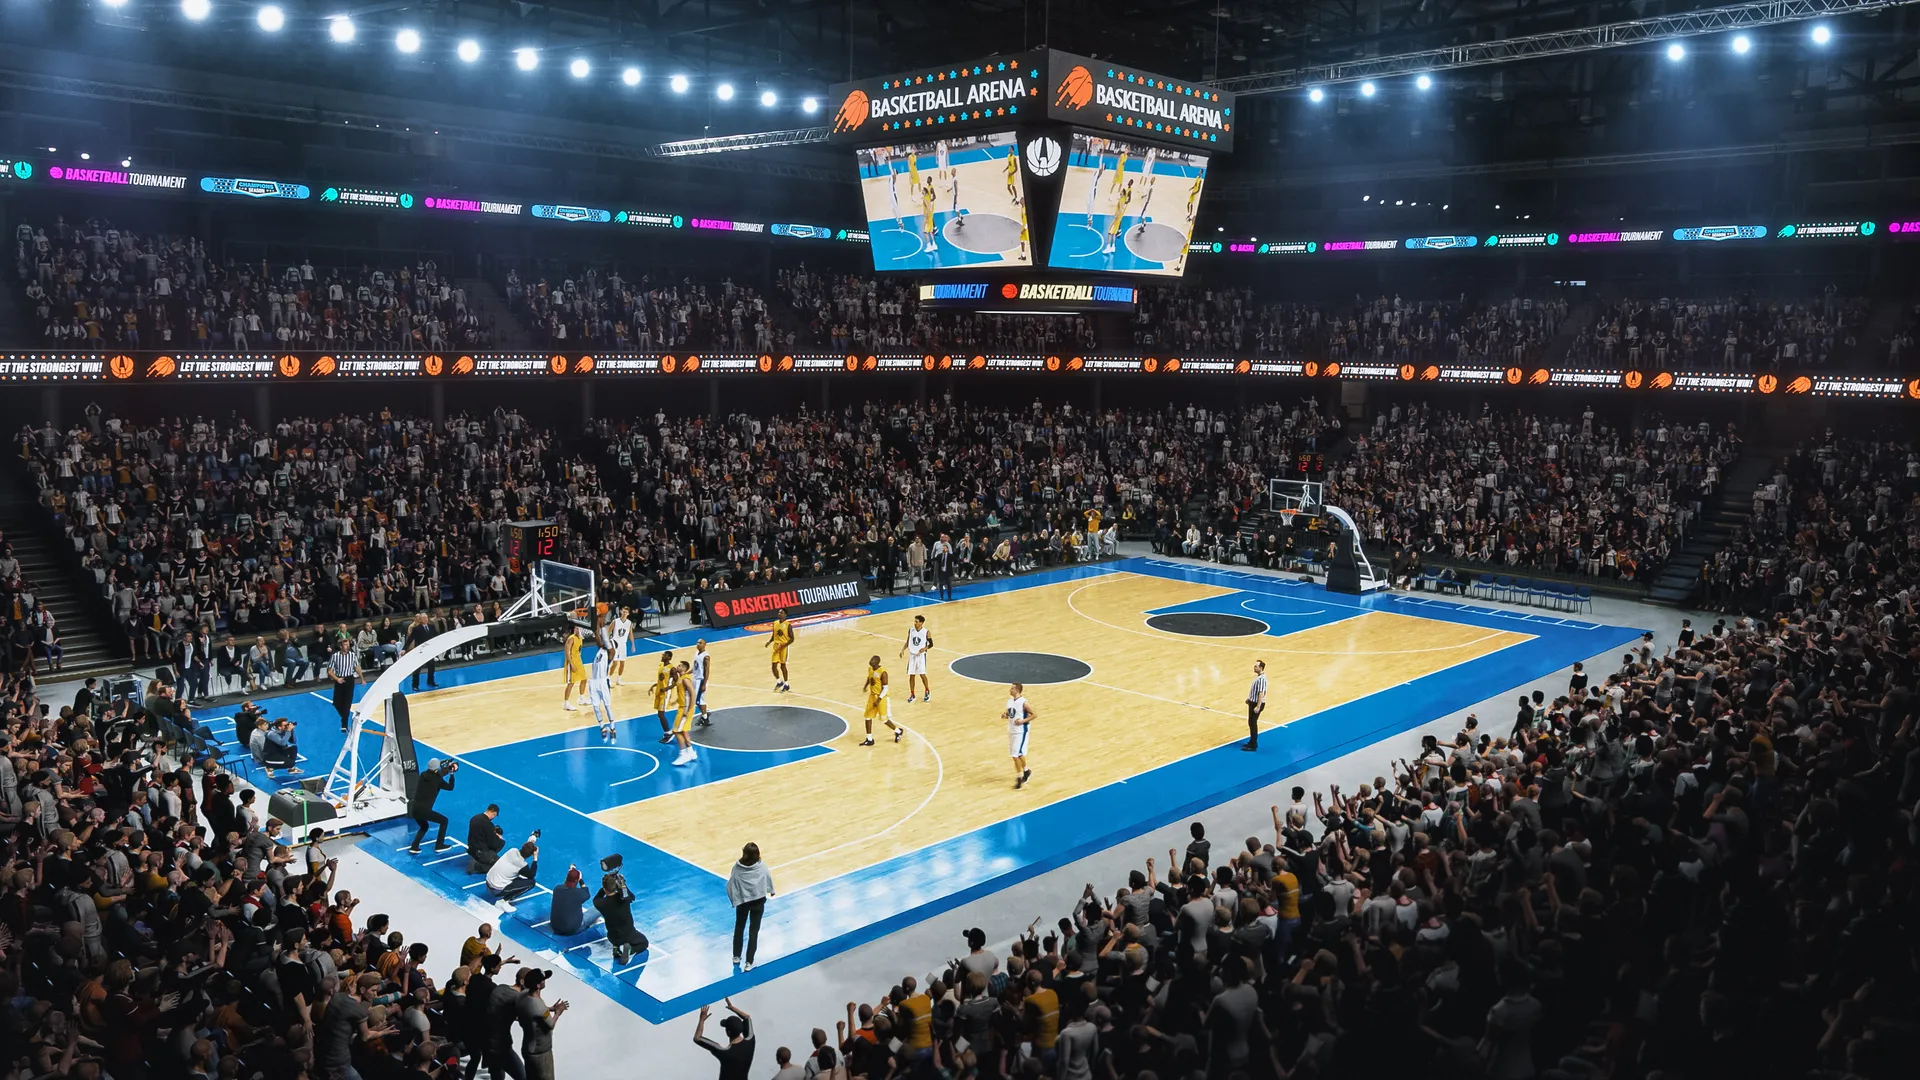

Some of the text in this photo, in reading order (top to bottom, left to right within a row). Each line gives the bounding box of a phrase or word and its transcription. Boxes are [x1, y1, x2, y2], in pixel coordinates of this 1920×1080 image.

[872, 77, 1026, 118] BASKETBALL ARENA
[1096, 84, 1222, 130] BASKETBALL ARENA
[239, 182, 274, 190] CHAMPIONS
[0, 362, 103, 374] ET THE STRONGEST WIN!
[180, 362, 274, 372] LET THE STRONGEST WIN!
[339, 361, 420, 371] LET THE STRONGEST WIN!
[476, 361, 547, 370] LET THE STRONGEST WIN!
[596, 360, 658, 369] LET THE STRONGEST WIN!
[1551, 373, 1621, 383] LET THE STRONGEST WIN!
[1675, 377, 1753, 387] LET THE STRONGEST WIN!
[1815, 382, 1903, 392] LET THE STRONGEST WIN!
[173, 502, 180, 511] 7
[538, 526, 558, 538] 1:50
[537, 539, 553, 556] 12
[178, 565, 185, 575] 7
[199, 563, 206, 573] 7
[232, 577, 240, 586] 7
[418, 574, 425, 583] 7
[202, 598, 209, 608] 7
